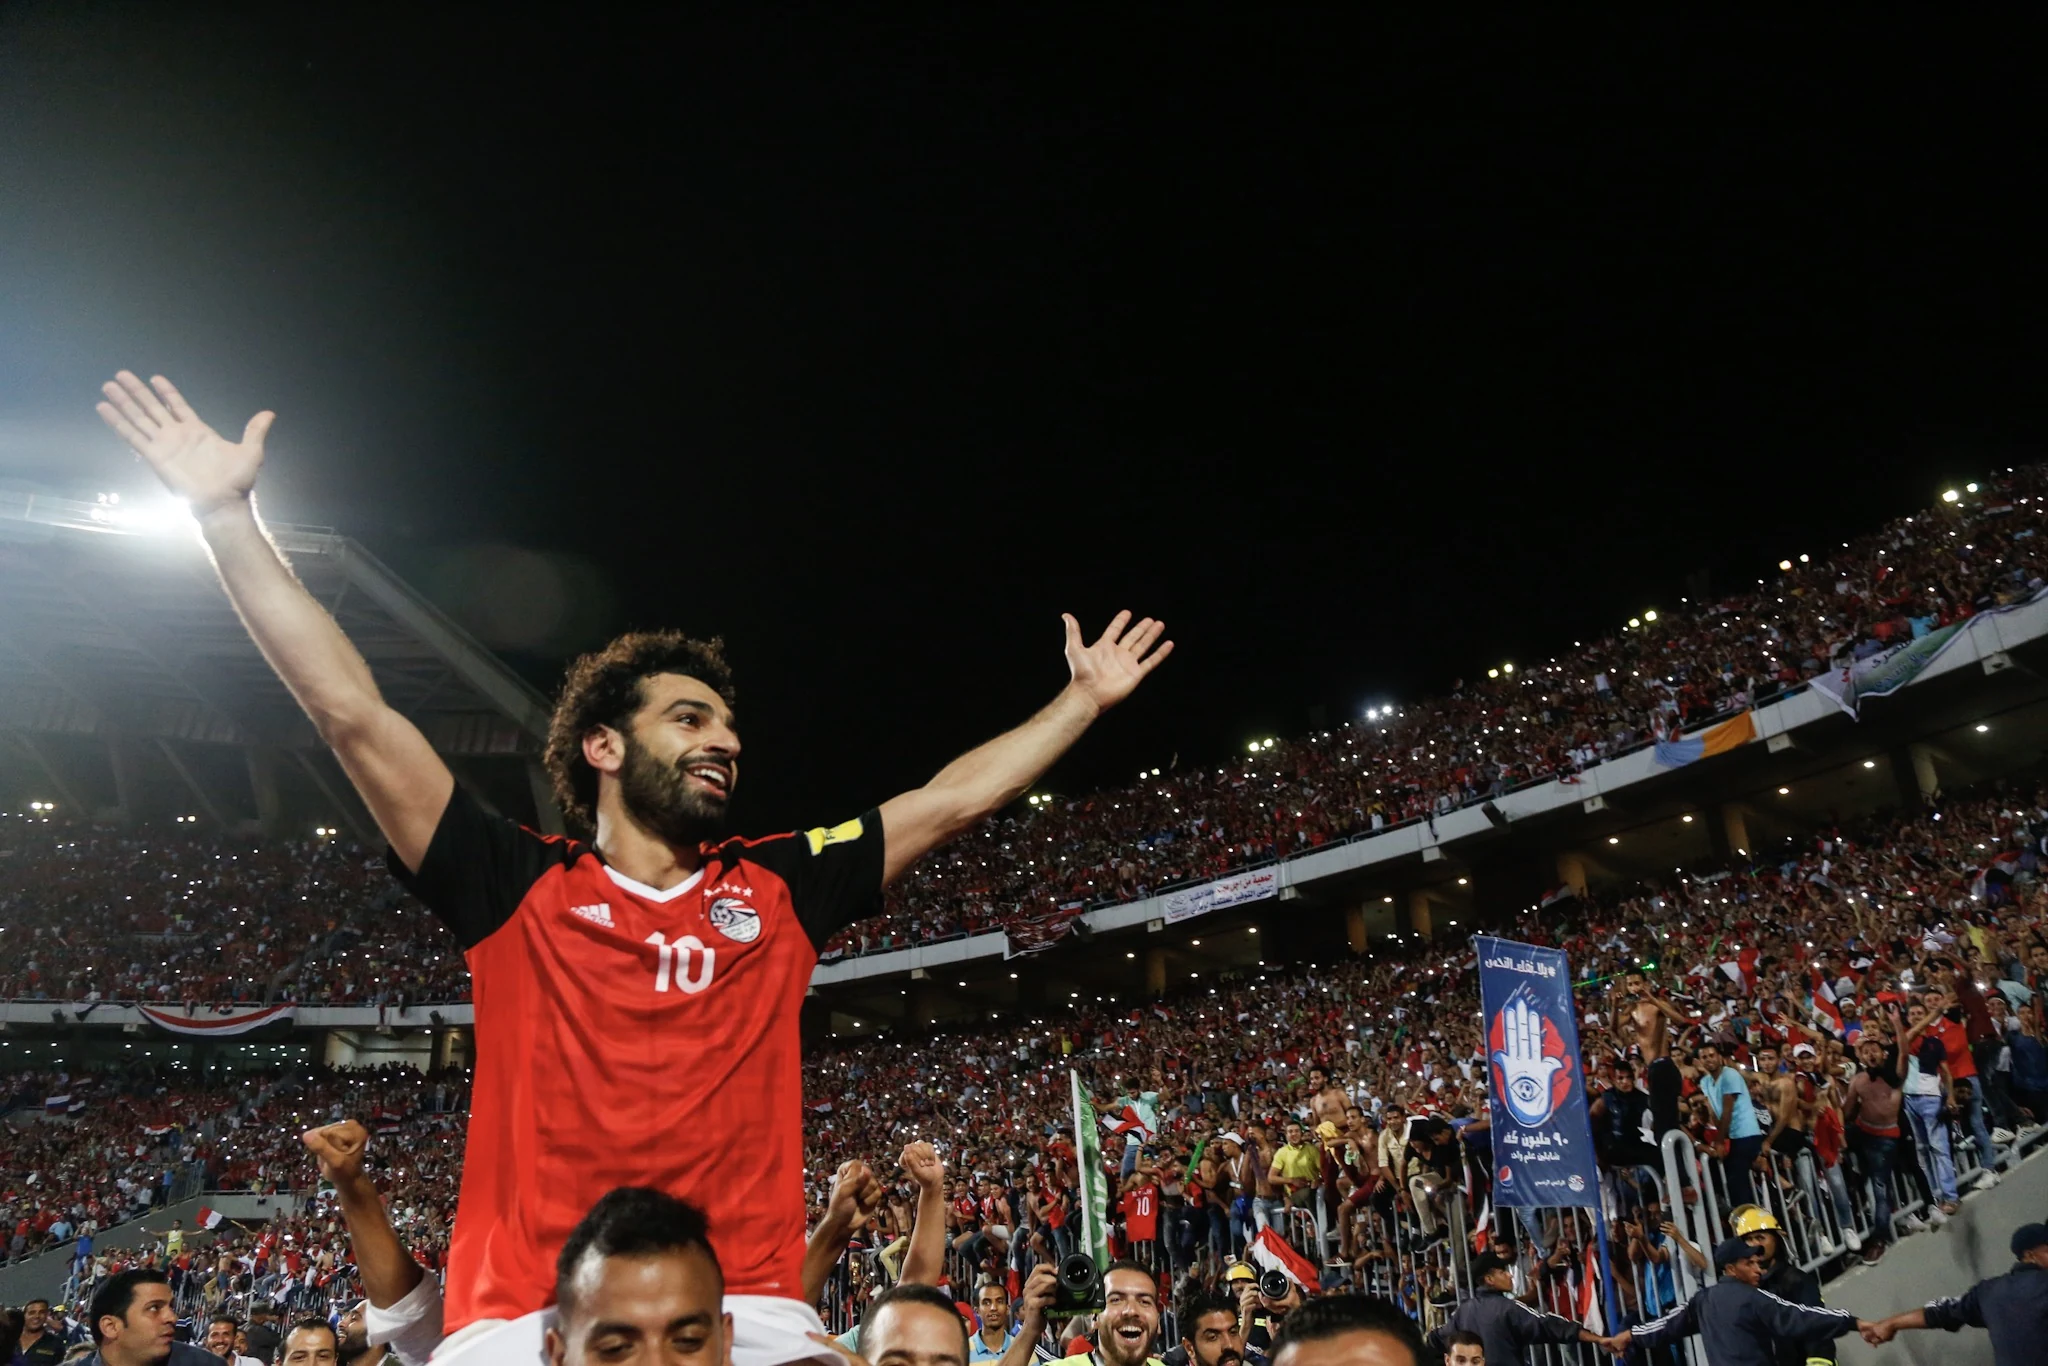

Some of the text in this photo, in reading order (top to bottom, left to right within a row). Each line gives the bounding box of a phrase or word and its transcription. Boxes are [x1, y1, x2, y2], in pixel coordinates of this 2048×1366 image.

[644, 931, 715, 994] 10
[1503, 1130, 1518, 1144] كف
[1522, 1132, 1551, 1149] مليون
[1524, 1151, 1536, 1163] علم
[1136, 1196, 1150, 1216] 10
